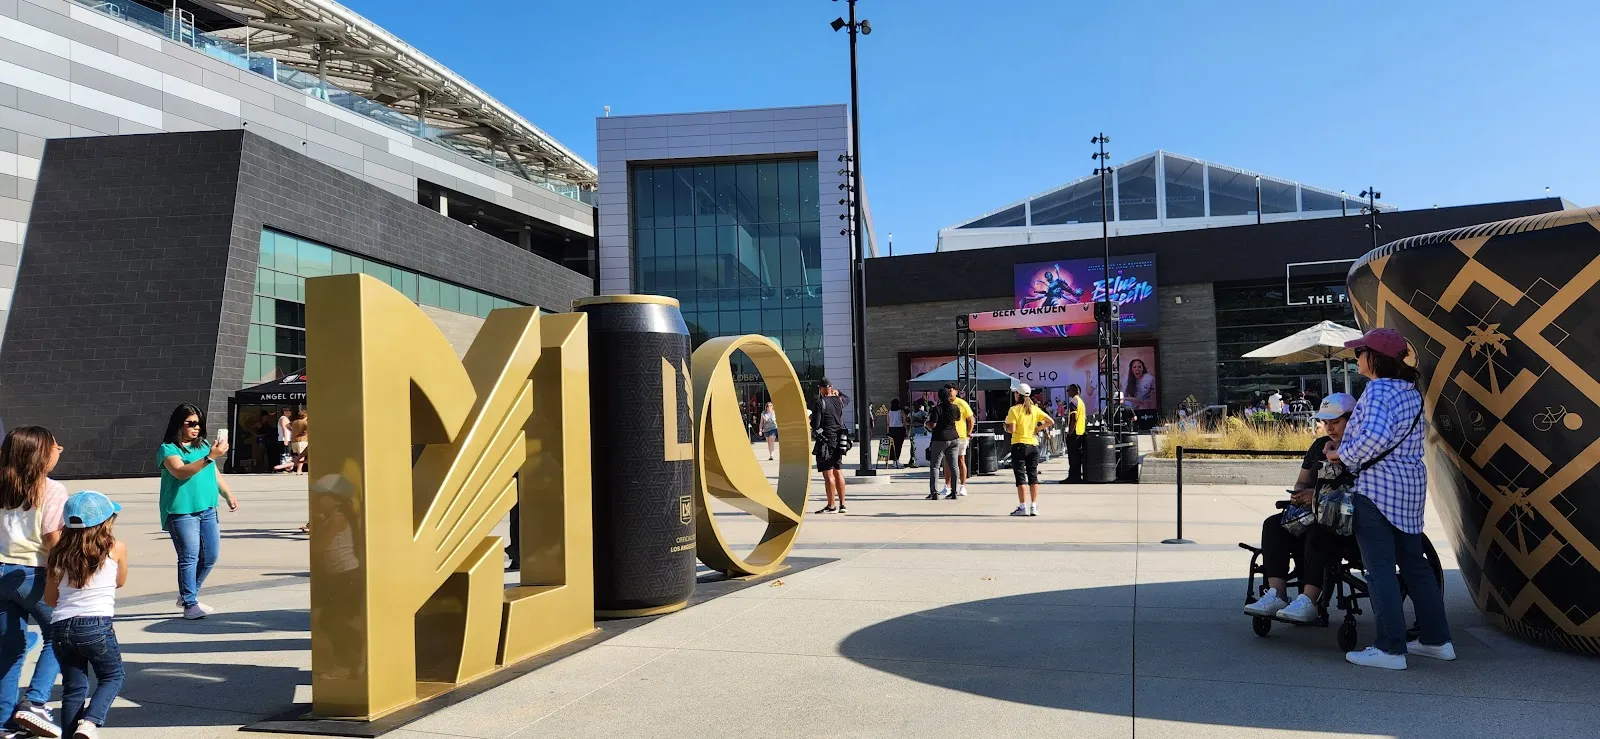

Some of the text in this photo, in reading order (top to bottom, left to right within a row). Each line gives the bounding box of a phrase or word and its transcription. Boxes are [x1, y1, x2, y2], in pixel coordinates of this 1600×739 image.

[1091, 276, 1137, 301] Blue
[1308, 294, 1333, 304] THE
[1021, 305, 1066, 315] GARDEN
[732, 373, 760, 382] LOBBY
[1039, 371, 1058, 382] HQ
